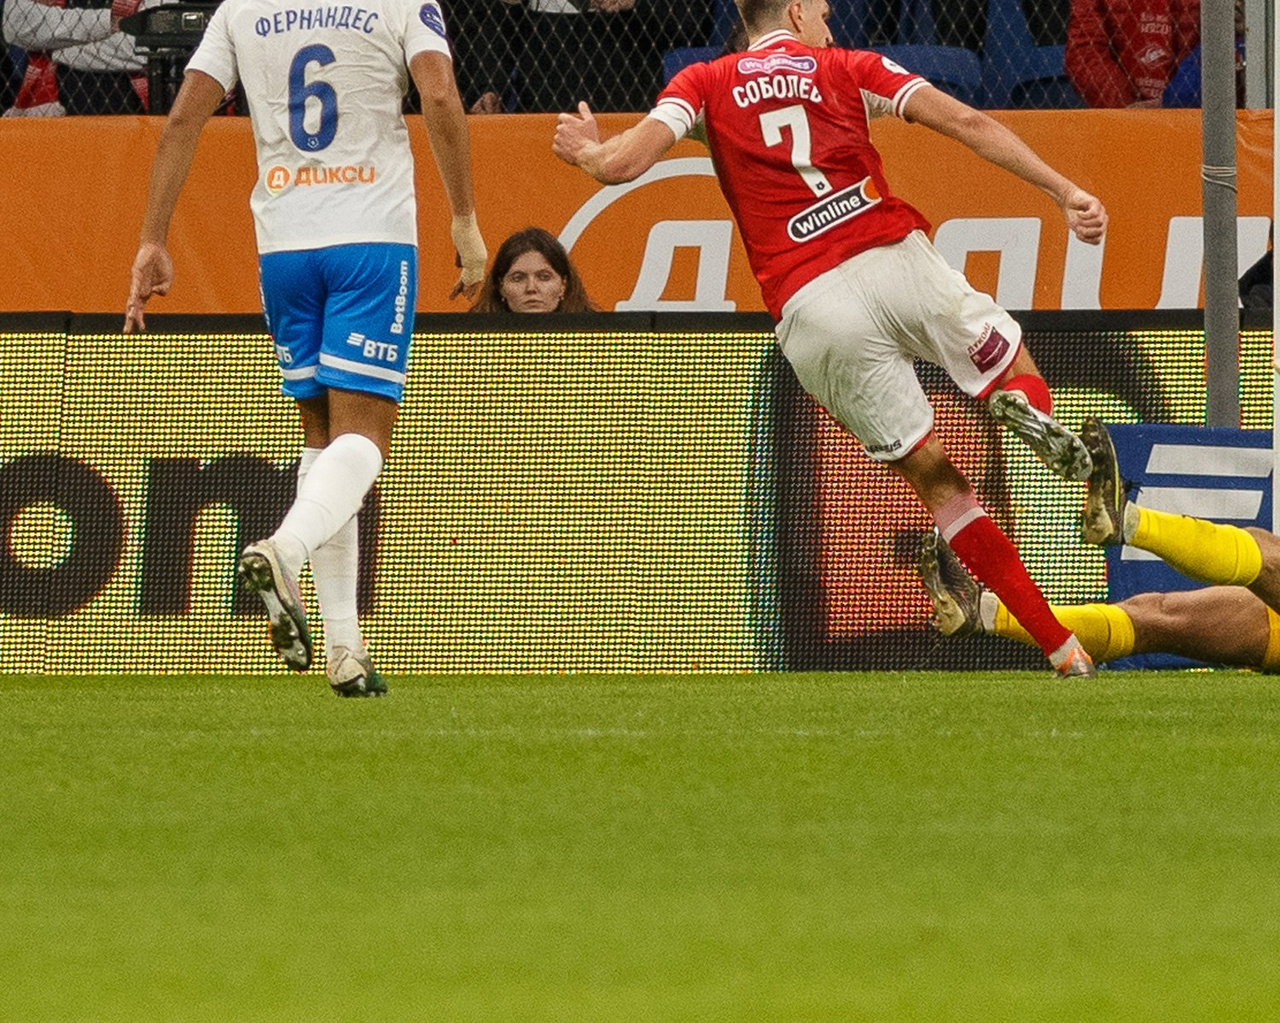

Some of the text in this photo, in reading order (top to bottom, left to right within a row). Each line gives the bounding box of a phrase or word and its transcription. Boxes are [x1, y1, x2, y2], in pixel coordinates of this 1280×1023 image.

[255, 5, 378, 37] ФЕРНАНДЕС
[288, 43, 338, 152] 6
[758, 104, 833, 198] 7
[796, 197, 862, 236] Winline
[390, 260, 408, 334] BetBoom
[362, 339, 398, 362] ВТБ
